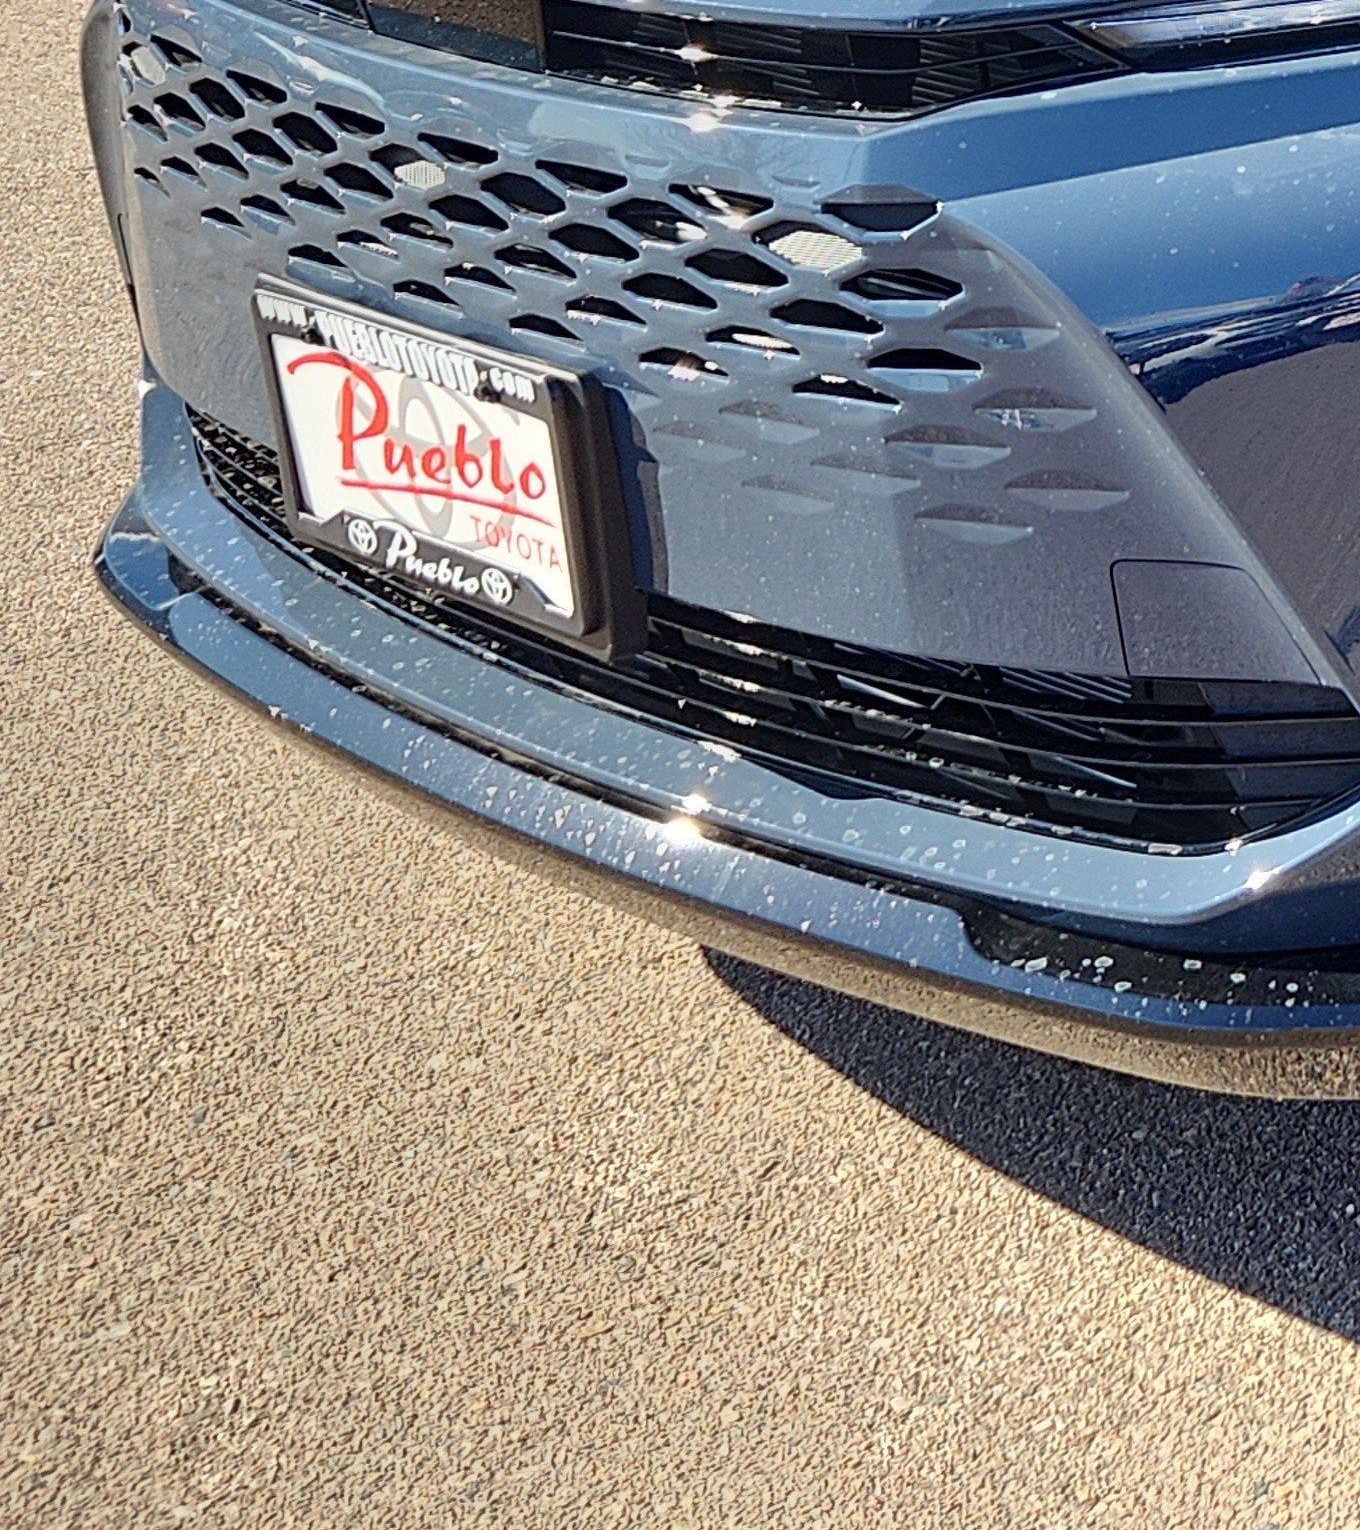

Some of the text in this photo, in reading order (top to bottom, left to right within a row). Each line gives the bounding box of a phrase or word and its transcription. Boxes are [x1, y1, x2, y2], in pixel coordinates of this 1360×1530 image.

[287, 351, 546, 500] Pueblo
[373, 520, 480, 594] Pueblo
[469, 514, 564, 574] TOYOTA
